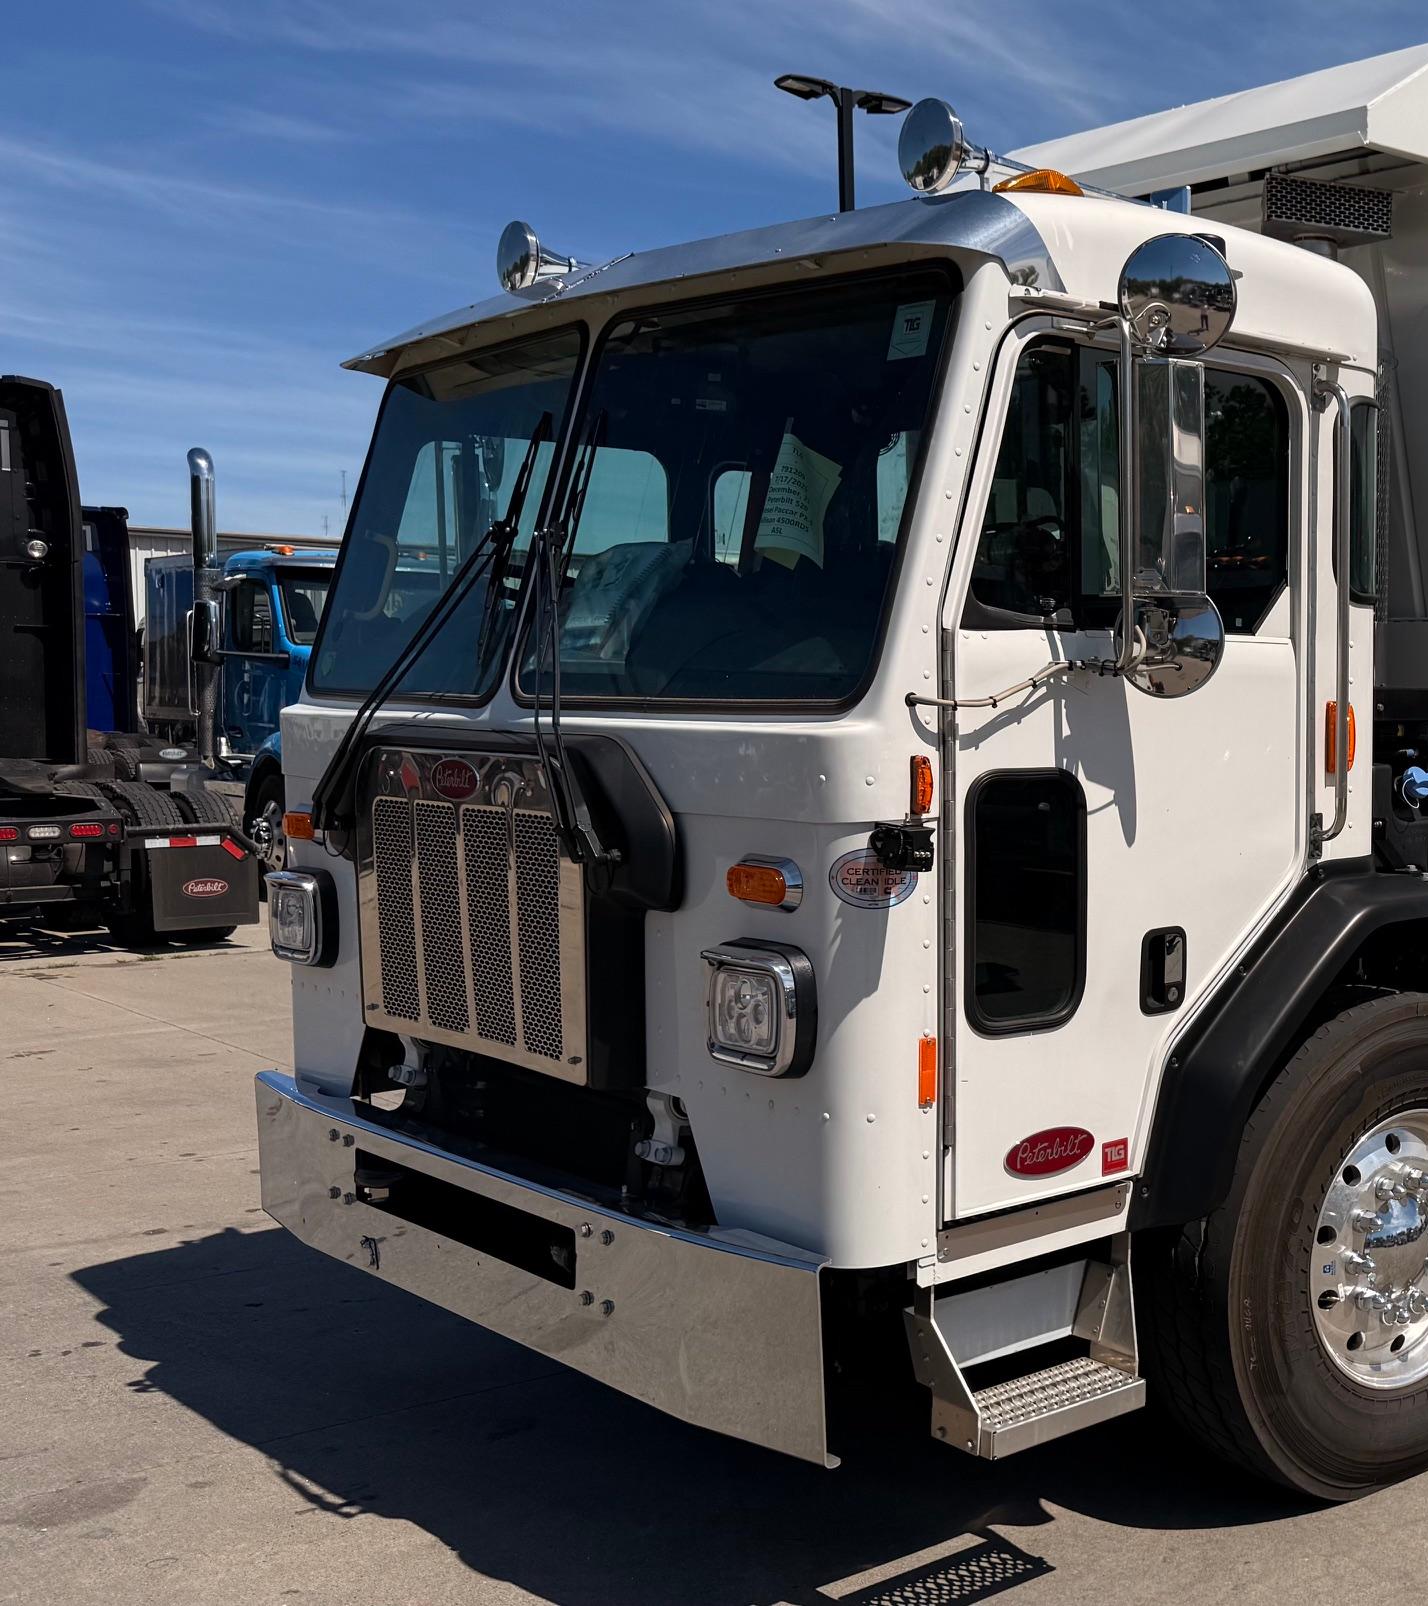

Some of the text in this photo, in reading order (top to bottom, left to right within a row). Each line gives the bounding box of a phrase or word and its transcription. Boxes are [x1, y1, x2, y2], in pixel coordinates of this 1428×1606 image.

[436, 765, 472, 788] Peterbilt
[847, 867, 902, 876] CERTIFIED
[188, 882, 225, 893] Peterbilt
[841, 876, 907, 886] CLEAN IDLE
[1016, 1133, 1088, 1170] Peterbilt
[1104, 1145, 1125, 1162] TLG
